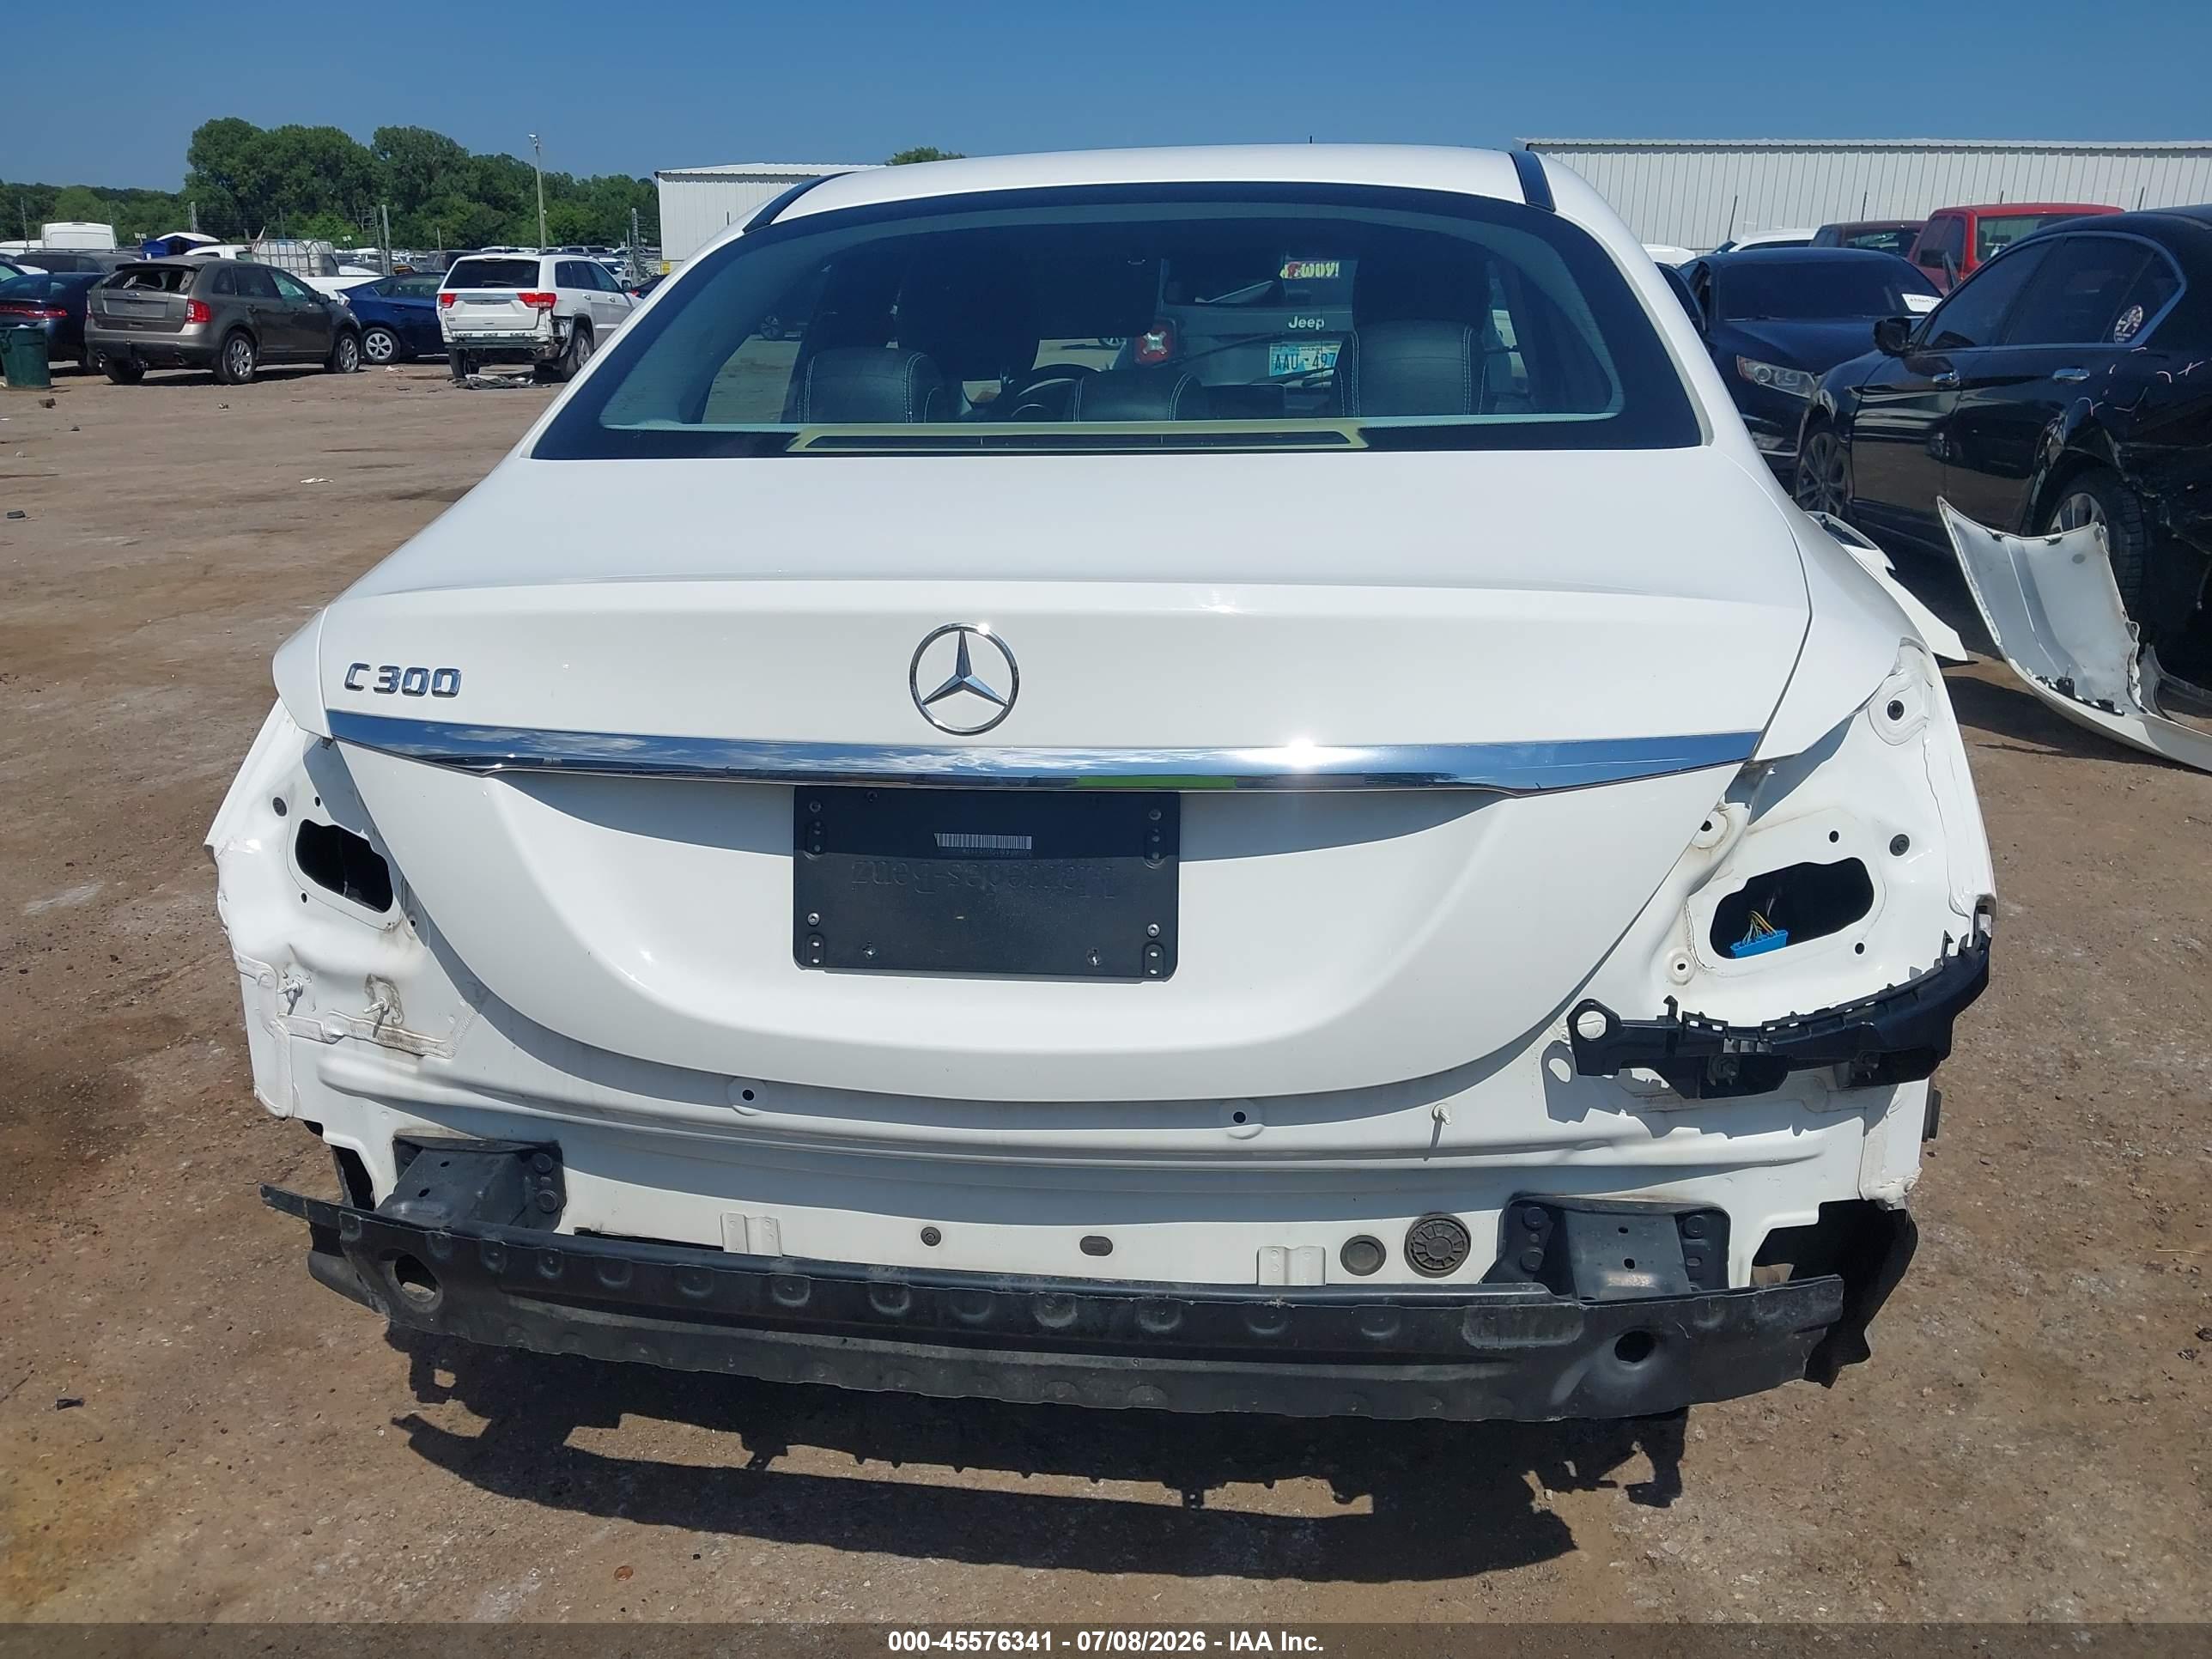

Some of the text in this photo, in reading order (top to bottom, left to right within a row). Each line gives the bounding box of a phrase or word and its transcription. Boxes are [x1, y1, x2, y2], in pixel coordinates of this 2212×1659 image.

[1288, 315, 1325, 330] Jeep
[344, 662, 462, 698] C 300
